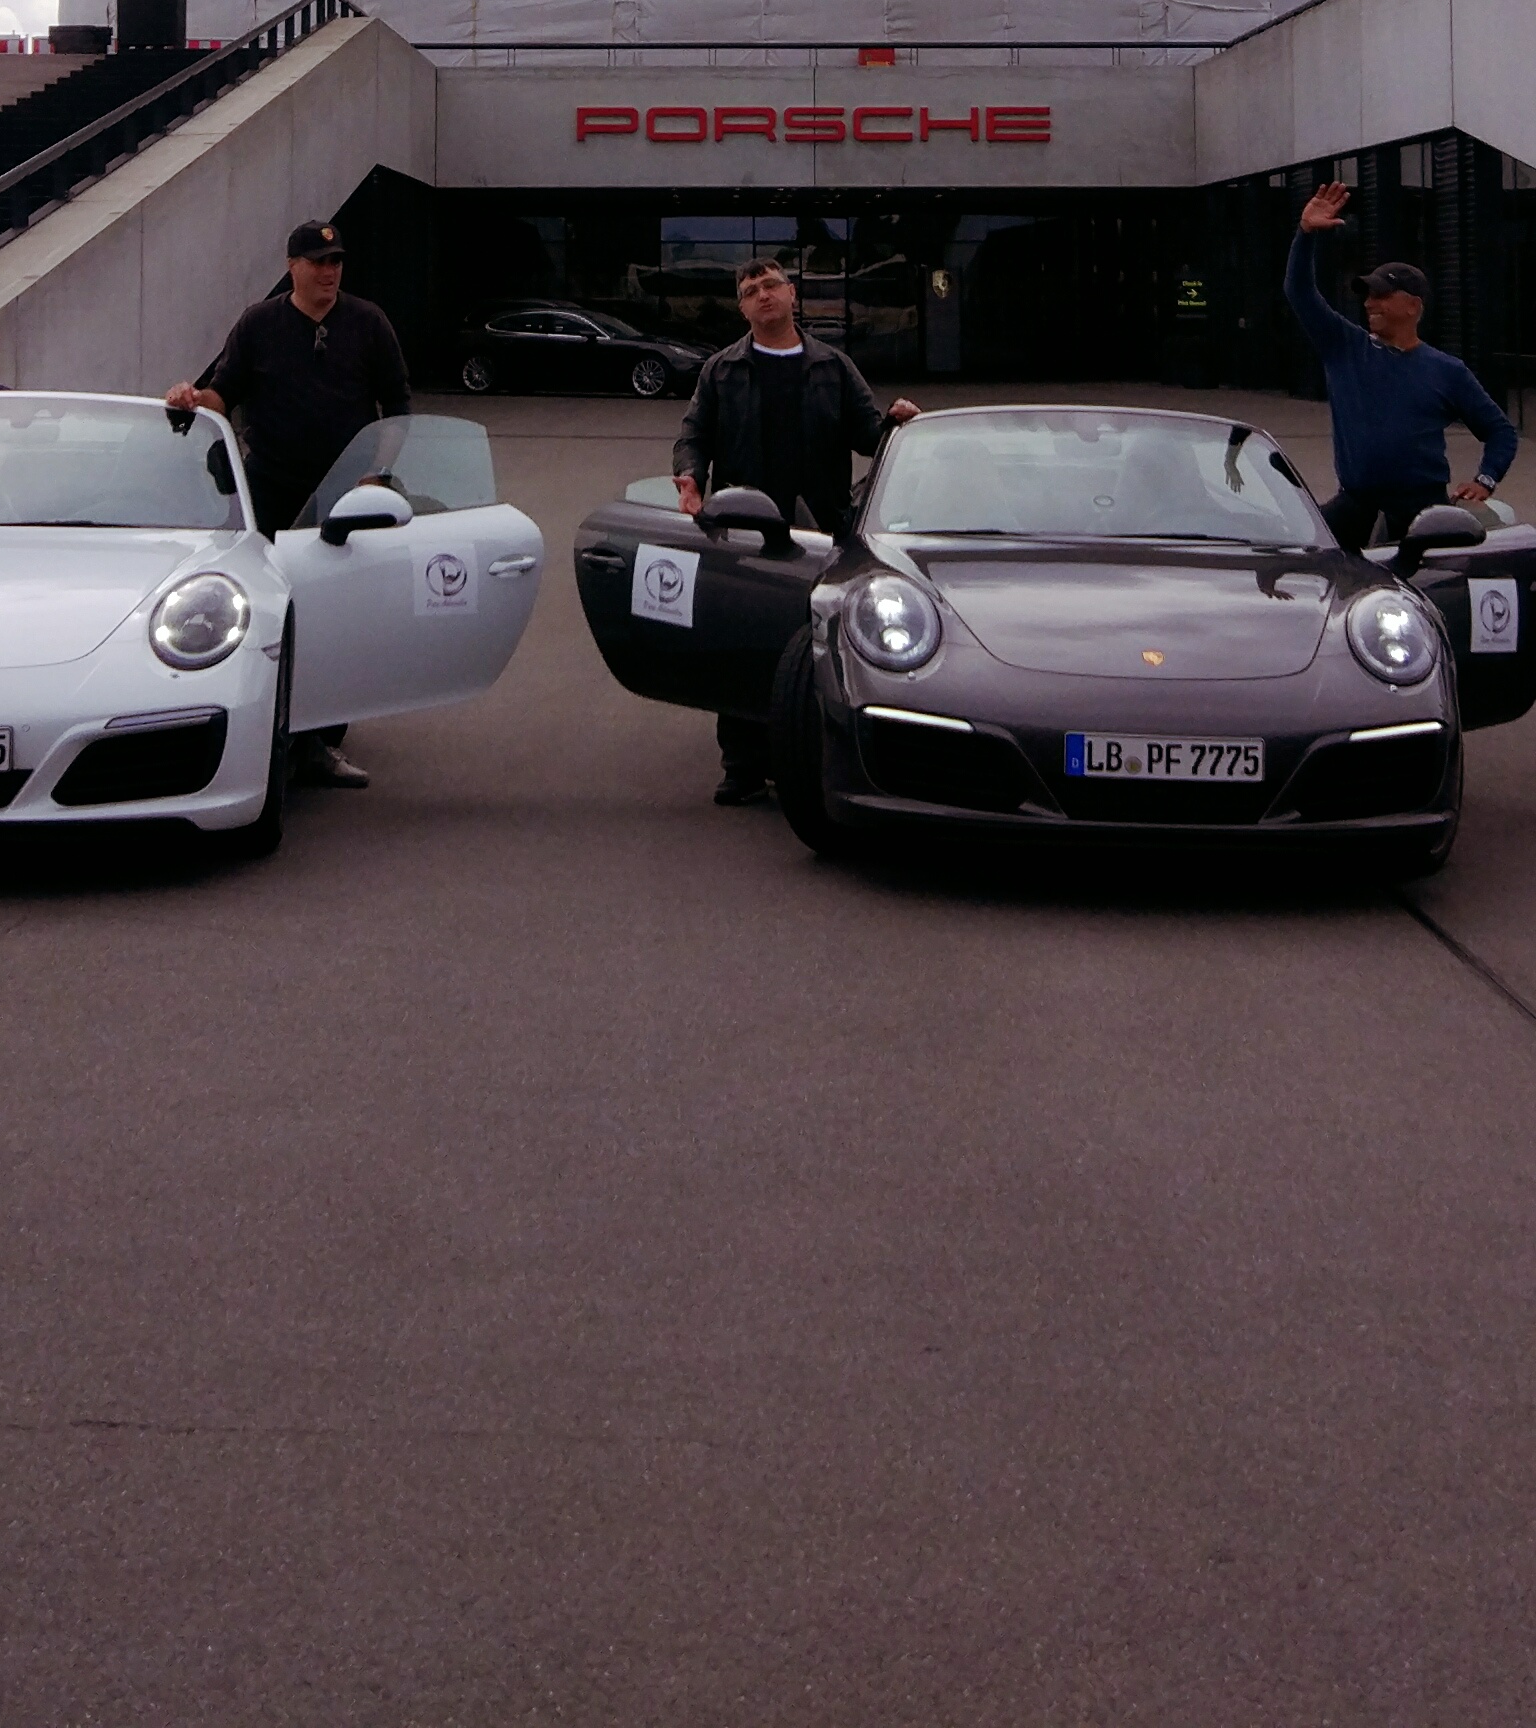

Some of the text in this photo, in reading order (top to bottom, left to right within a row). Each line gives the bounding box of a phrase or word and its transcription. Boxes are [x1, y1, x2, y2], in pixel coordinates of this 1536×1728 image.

[575, 106, 1052, 142] PORSCHE
[1086, 740, 1123, 772] LB
[1147, 743, 1183, 775] PF
[1190, 744, 1259, 776] 7775
